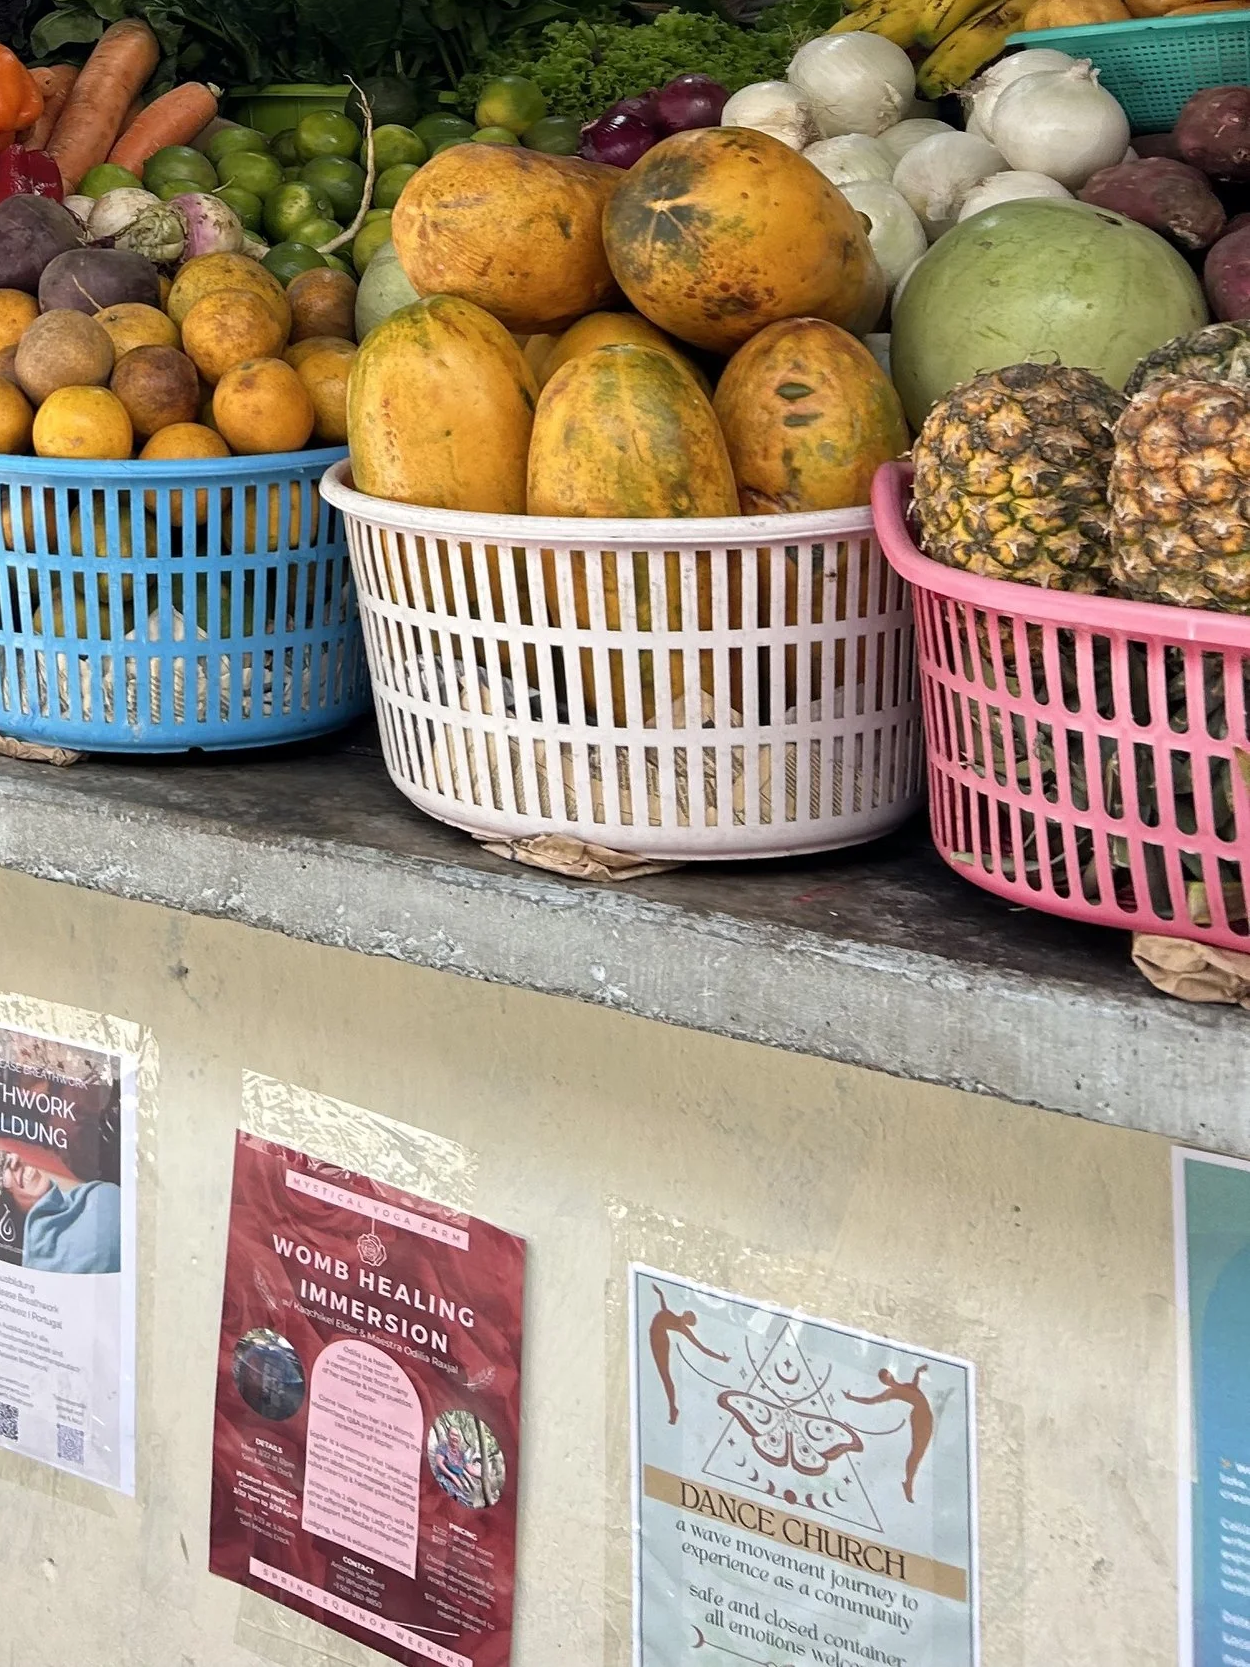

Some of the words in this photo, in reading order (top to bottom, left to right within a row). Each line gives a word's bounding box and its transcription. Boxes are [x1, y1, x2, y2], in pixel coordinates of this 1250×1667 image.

[22, 1064, 88, 1090] BREATHWORK
[293, 1178, 363, 1209] MYSTICAL
[373, 1205, 412, 1226] YOGA
[421, 1222, 461, 1242] FARM
[18, 1293, 59, 1313] Breathwork
[273, 1234, 349, 1281] WOMB
[359, 1268, 475, 1328] HEALING
[31, 1311, 63, 1329] Portugal
[300, 1279, 448, 1354] IMMERSION
[336, 1318, 359, 1335] Elder
[360, 1328, 366, 1338] &
[366, 1332, 402, 1352] Maestra
[403, 1343, 430, 1363] Odilia
[255, 1437, 283, 1454] DETAILS
[680, 1482, 775, 1537] DANCE
[782, 1518, 906, 1580] CHURCH
[342, 1556, 375, 1575] CONTACT
[675, 1519, 686, 1532] a
[690, 1523, 732, 1548] wave
[736, 1539, 826, 1581] movement
[830, 1569, 897, 1608] journey
[901, 1594, 919, 1612] to
[682, 1540, 770, 1583] experience
[774, 1576, 794, 1590] as
[799, 1582, 810, 1595] a
[815, 1586, 913, 1635] community
[262, 1567, 313, 1598] SPRING
[323, 1596, 387, 1632] EQUINOX
[396, 1631, 465, 1667] WEEKEND
[689, 1584, 724, 1606] safe
[728, 1601, 759, 1620] and
[765, 1608, 818, 1641] closed
[823, 1632, 907, 1667] container
[705, 1610, 724, 1628] all
[729, 1622, 806, 1656] emotions
